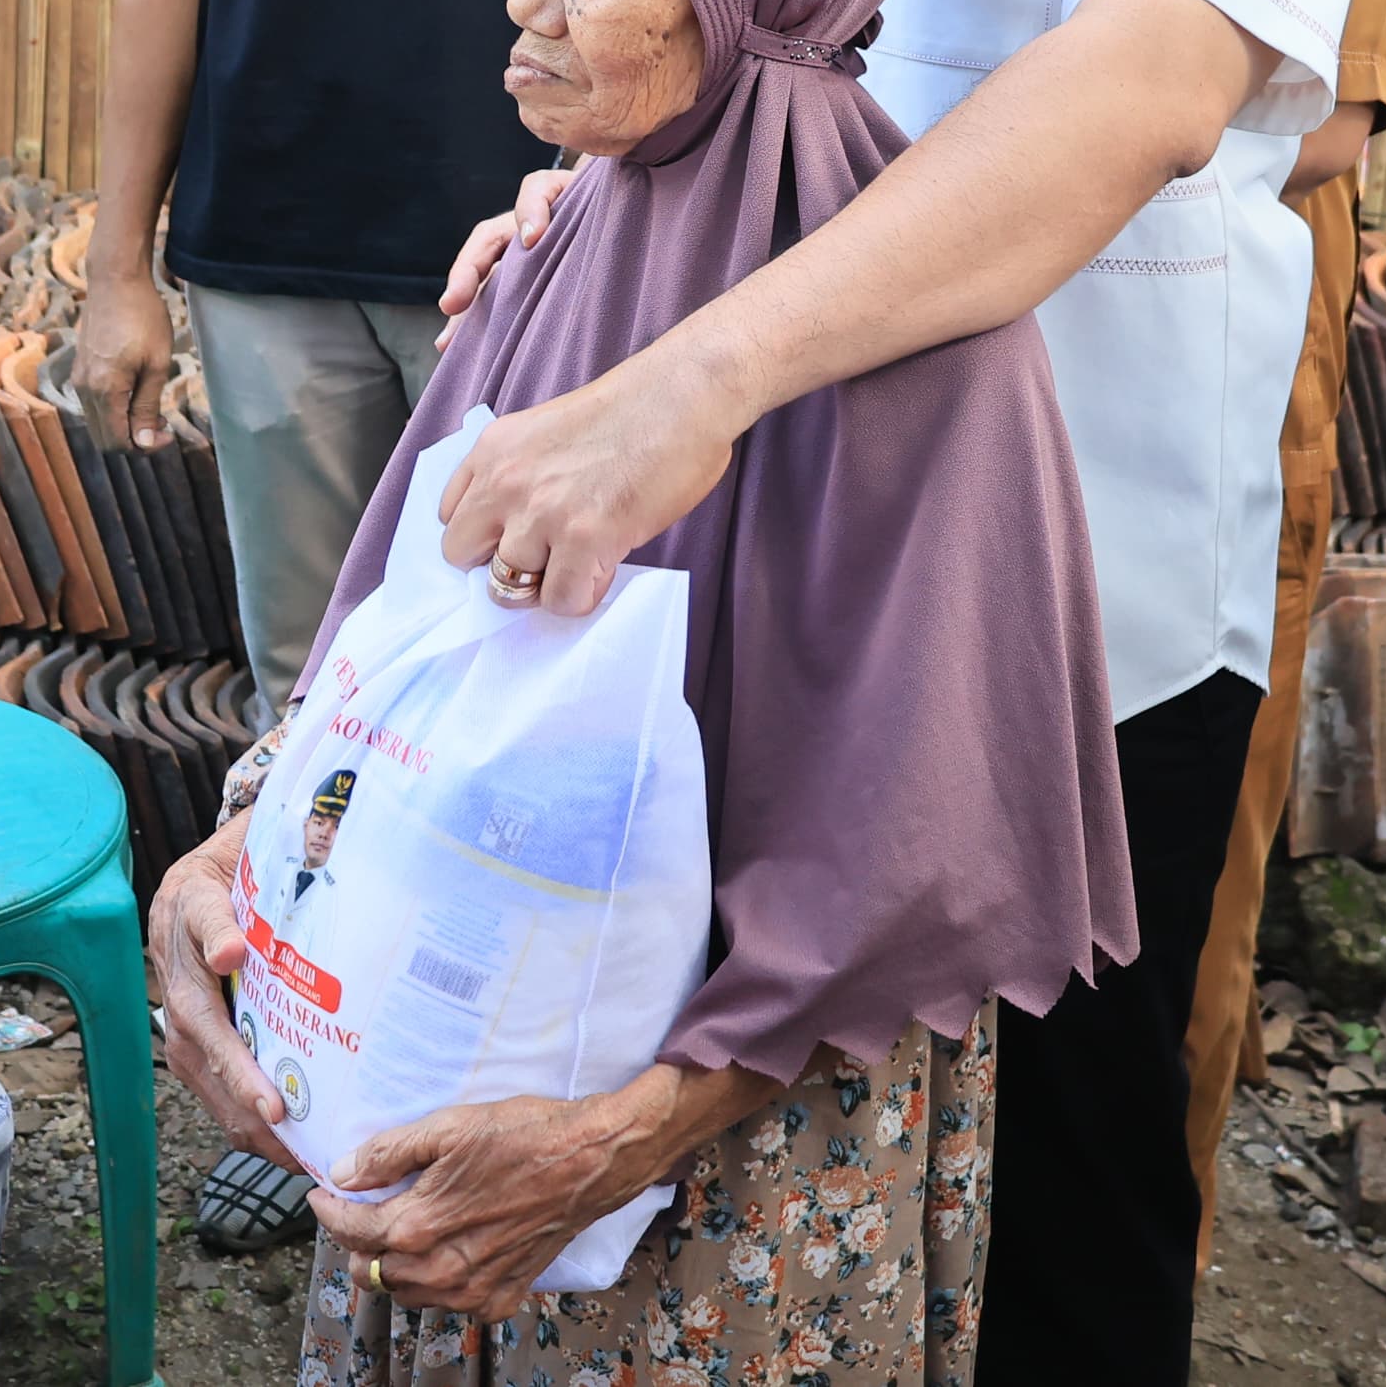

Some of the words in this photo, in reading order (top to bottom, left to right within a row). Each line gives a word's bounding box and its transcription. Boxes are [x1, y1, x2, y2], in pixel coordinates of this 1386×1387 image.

[264, 982, 291, 1017] OTA
[294, 1001, 361, 1053] SERANG
[265, 1005, 314, 1058] ERANG
